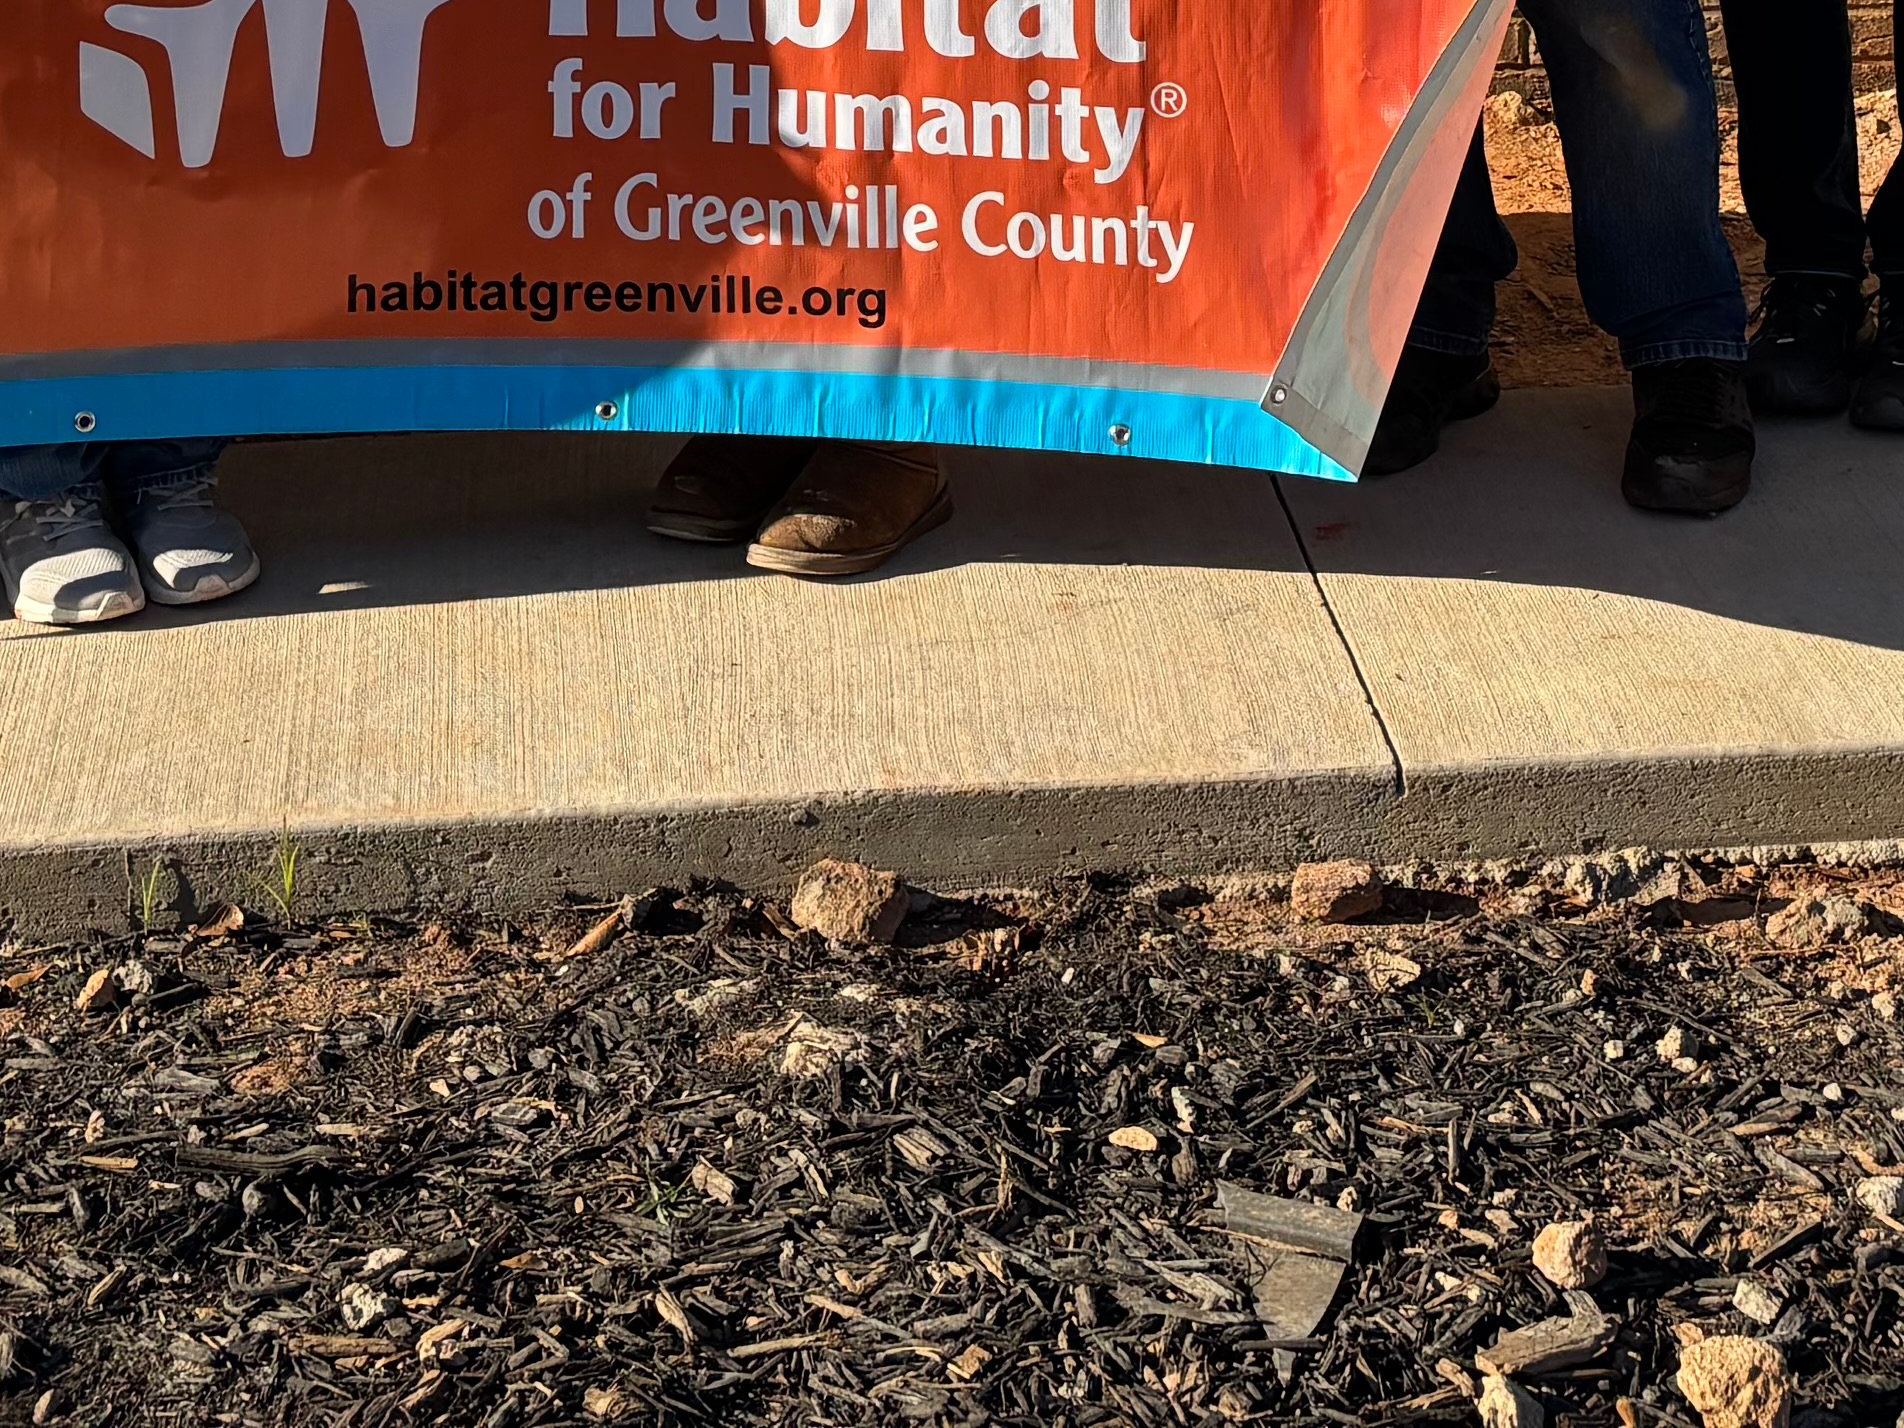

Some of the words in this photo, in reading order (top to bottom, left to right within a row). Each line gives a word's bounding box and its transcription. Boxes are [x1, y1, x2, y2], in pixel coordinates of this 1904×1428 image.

[548, 56, 676, 140] for
[527, 171, 593, 239] of
[613, 171, 939, 252] Greenville
[961, 190, 1195, 283] County
[346, 269, 888, 329] habitatgreenville.org
